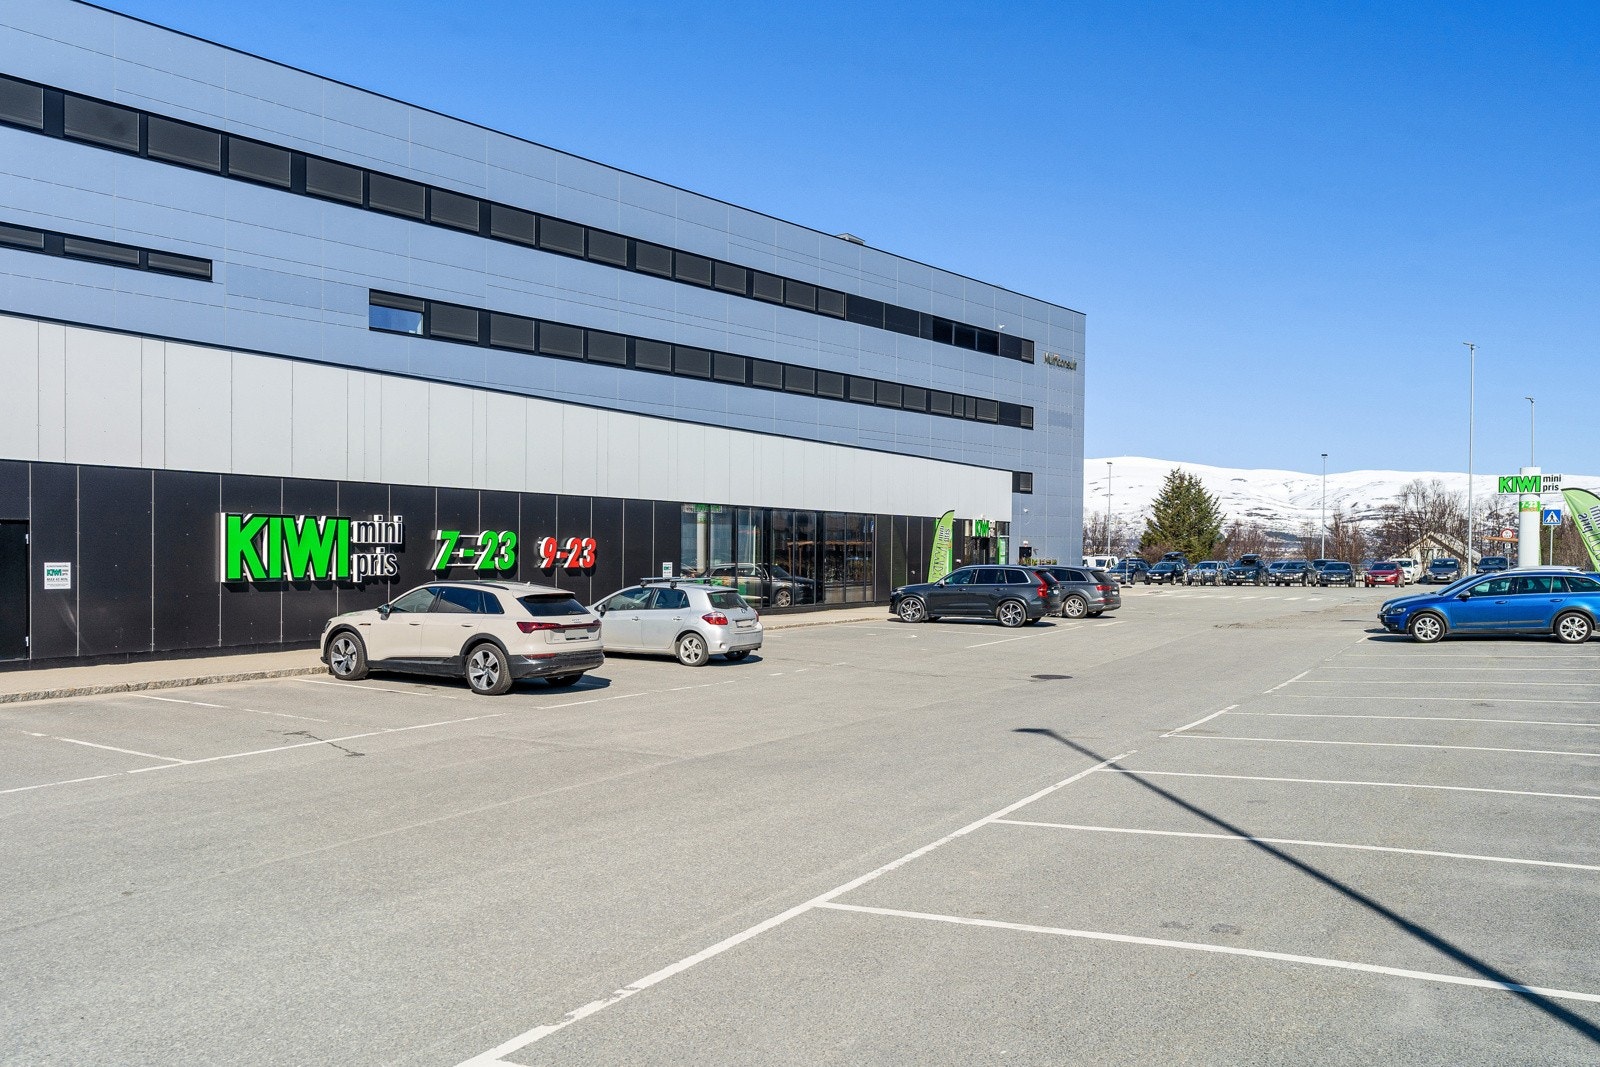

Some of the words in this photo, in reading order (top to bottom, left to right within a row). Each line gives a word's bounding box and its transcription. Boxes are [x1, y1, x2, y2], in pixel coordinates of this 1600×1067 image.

[1499, 475, 1541, 493] KIWI
[1542, 474, 1562, 482] mini
[1542, 482, 1559, 492] pris
[353, 514, 403, 544] mini
[222, 513, 351, 582] KIWI
[433, 530, 517, 570] 7-23
[541, 537, 597, 569] 9-23
[353, 547, 398, 582] pris
